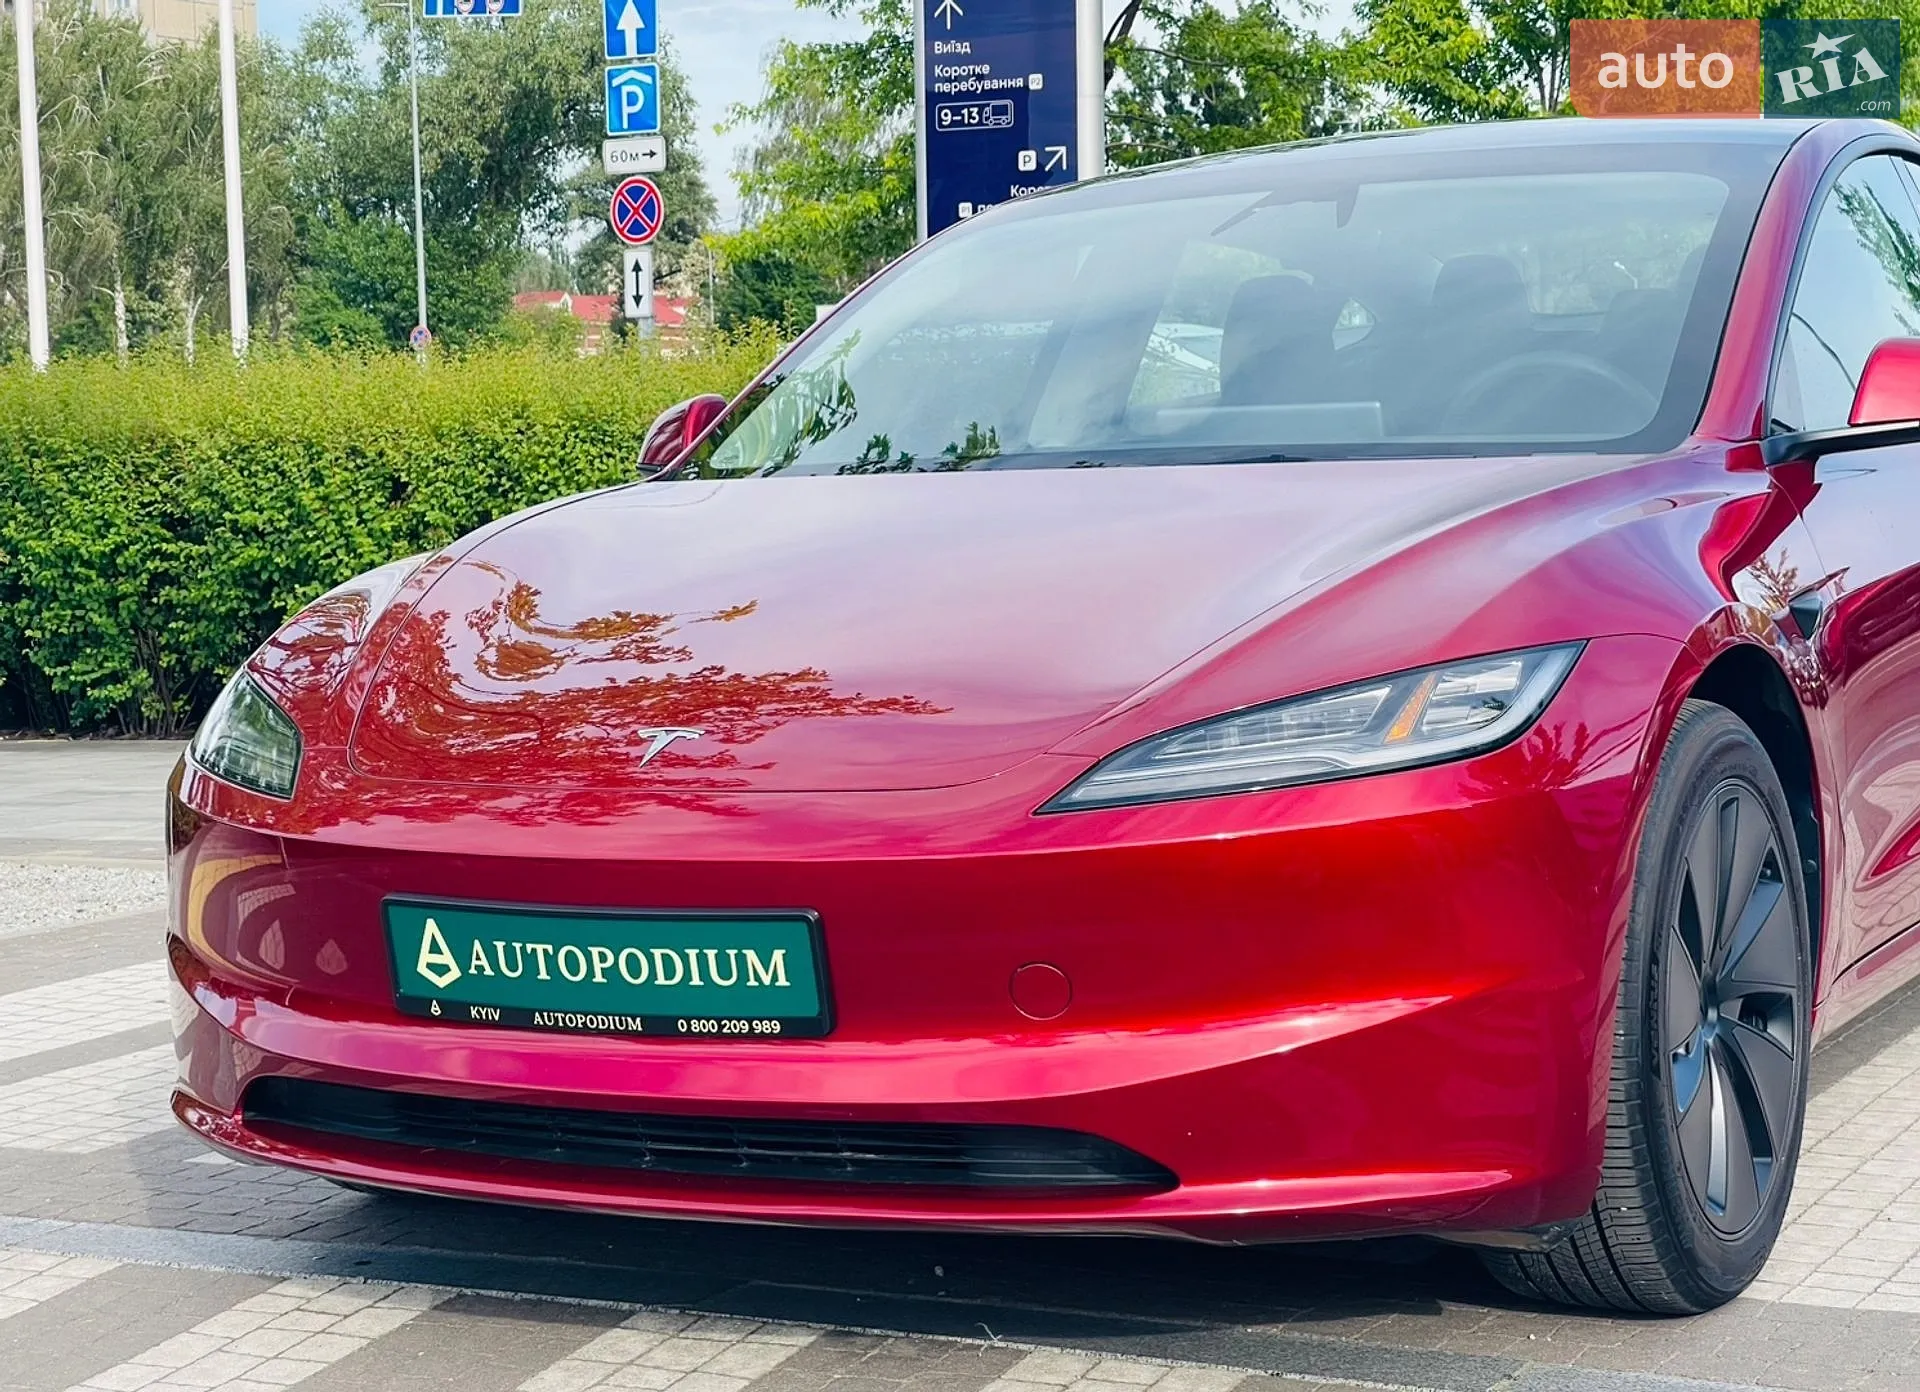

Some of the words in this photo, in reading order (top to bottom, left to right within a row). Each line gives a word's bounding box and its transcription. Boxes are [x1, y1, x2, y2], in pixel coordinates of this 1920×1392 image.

[934, 40, 972, 54] Виїзд
[934, 64, 990, 79] Коротке
[934, 77, 1024, 95] перебування
[1023, 154, 1032, 167] P
[468, 939, 791, 987] AUTOPODIUM
[470, 1005, 500, 1021] KYIV
[533, 1011, 643, 1031] AUTOPODIUM
[677, 1018, 688, 1033] 0
[690, 1019, 718, 1033] 800
[721, 1019, 749, 1034] 209
[752, 1020, 781, 1034] 989
